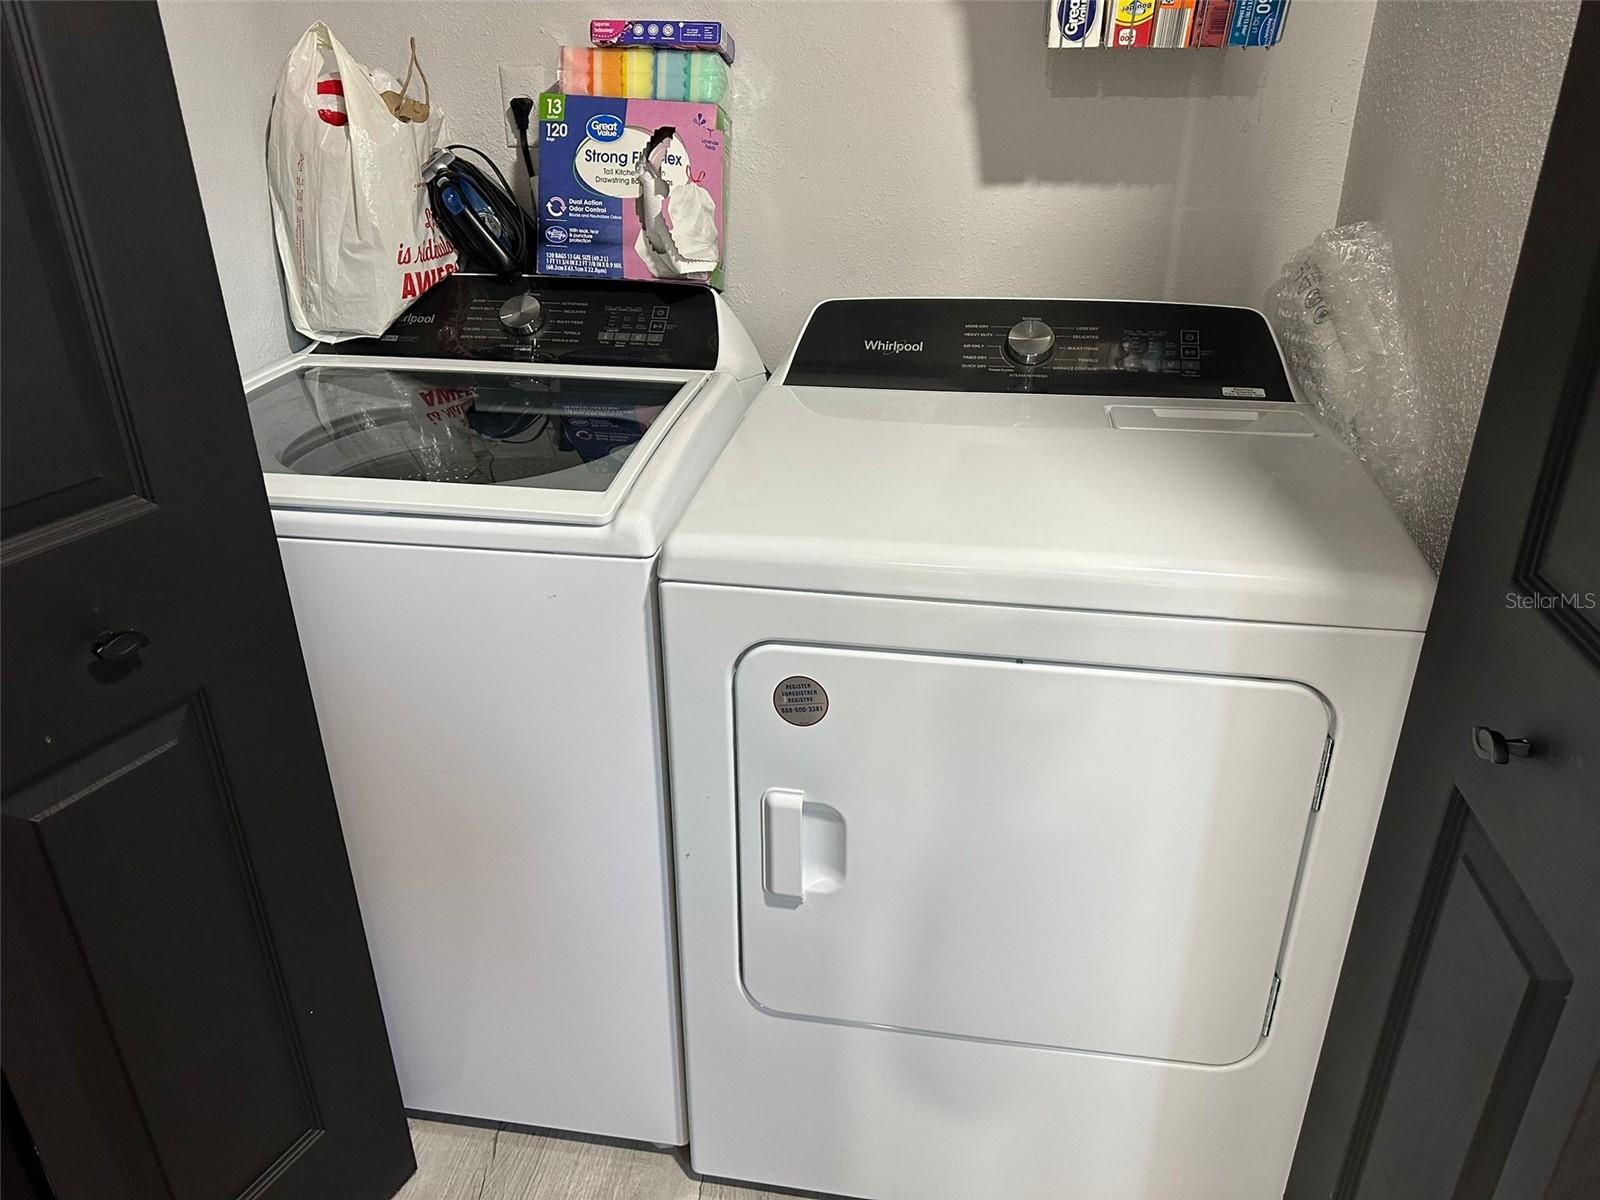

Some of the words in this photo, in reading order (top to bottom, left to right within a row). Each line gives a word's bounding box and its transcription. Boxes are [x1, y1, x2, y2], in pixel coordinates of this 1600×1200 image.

[546, 98, 562, 115] 13
[545, 123, 568, 137] 120
[591, 120, 618, 131] Great
[597, 129, 617, 137] Value
[584, 149, 628, 167] Strong
[595, 176, 630, 186] Drawstring
[397, 243, 411, 265] is
[404, 313, 436, 325] rlpool
[864, 339, 923, 354] Whirlpool
